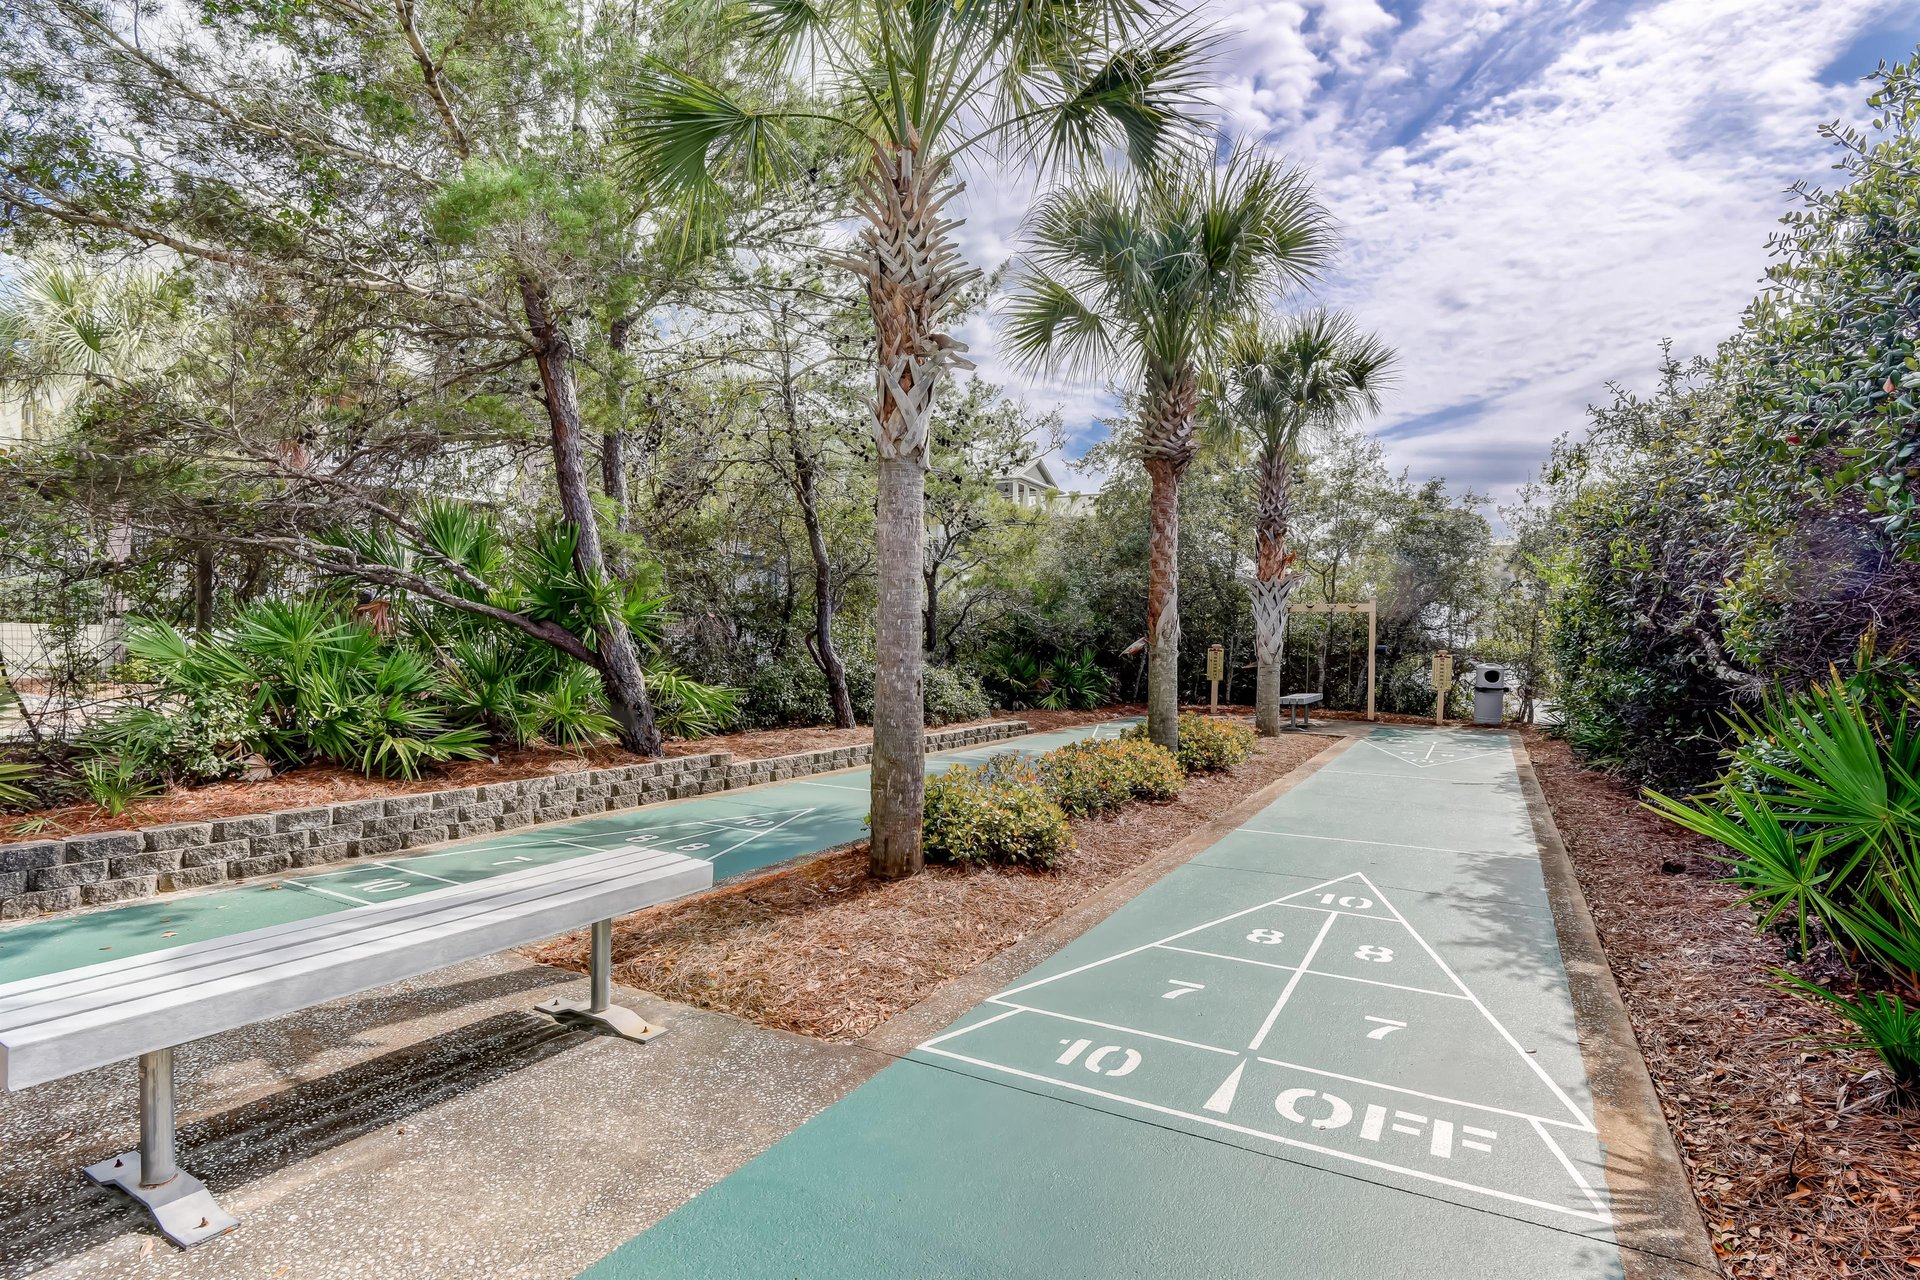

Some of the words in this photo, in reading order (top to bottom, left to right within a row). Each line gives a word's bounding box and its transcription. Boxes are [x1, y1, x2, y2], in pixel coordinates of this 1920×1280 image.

[625, 834, 660, 843] 8
[675, 842, 711, 851] 8
[351, 878, 411, 893] 10
[1314, 893, 1373, 909] 10
[1246, 928, 1285, 946] 8
[1353, 944, 1395, 964] 8
[1161, 979, 1206, 1000] 7
[1364, 1015, 1408, 1041] 7
[1055, 1037, 1143, 1077] 10
[1274, 1087, 1498, 1160] OFF
